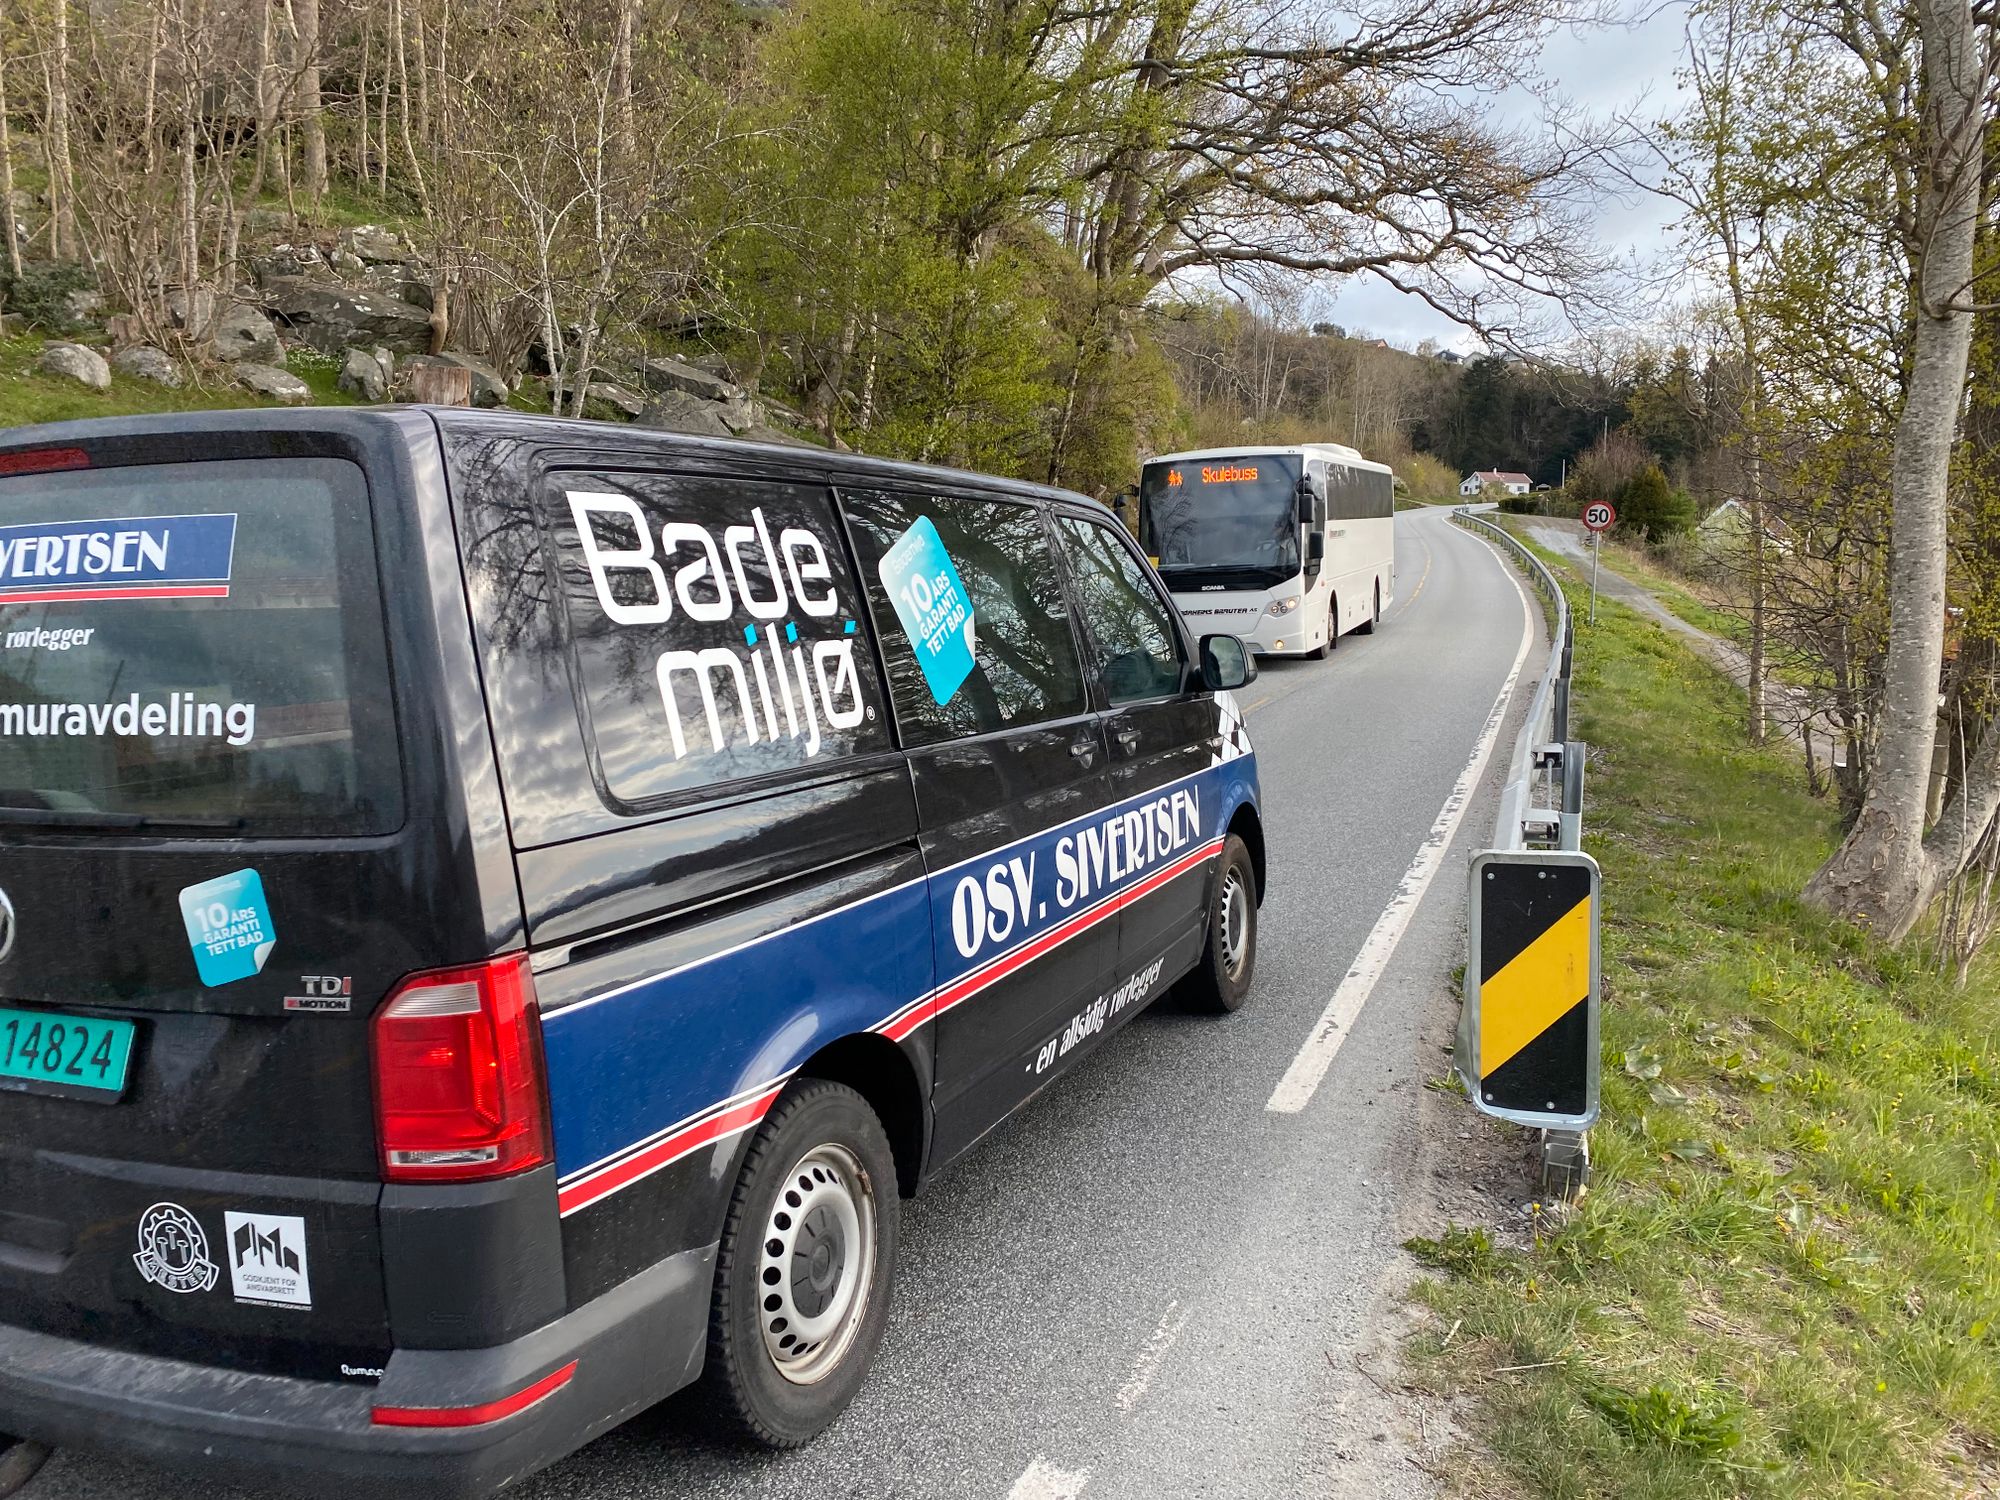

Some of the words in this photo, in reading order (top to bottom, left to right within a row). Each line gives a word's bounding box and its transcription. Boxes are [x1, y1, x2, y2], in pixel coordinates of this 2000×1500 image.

[1202, 466, 1258, 483] Skulebuss
[1588, 509, 1609, 523] 50
[0, 530, 169, 579] VERTSEN
[565, 491, 838, 624] Bade
[901, 573, 933, 622] 10
[919, 586, 959, 640] GARANTI
[5, 627, 95, 651] rørlegger
[926, 628, 950, 657] TETT
[947, 603, 965, 635] BAD
[0, 692, 256, 746] muravdeling
[952, 851, 1047, 958] OSV.
[1055, 784, 1200, 908] SIVERTSEN
[194, 902, 229, 932] 10
[203, 918, 261, 944] GARANTI
[206, 938, 235, 957] TETT
[237, 931, 264, 948] BAD
[301, 976, 352, 995] TDI
[5, 1019, 114, 1079] 14824
[1036, 1038, 1057, 1074] en
[1059, 995, 1109, 1058] allsidig
[145, 1258, 207, 1289] MESTER
[281, 1278, 297, 1287] FOR
